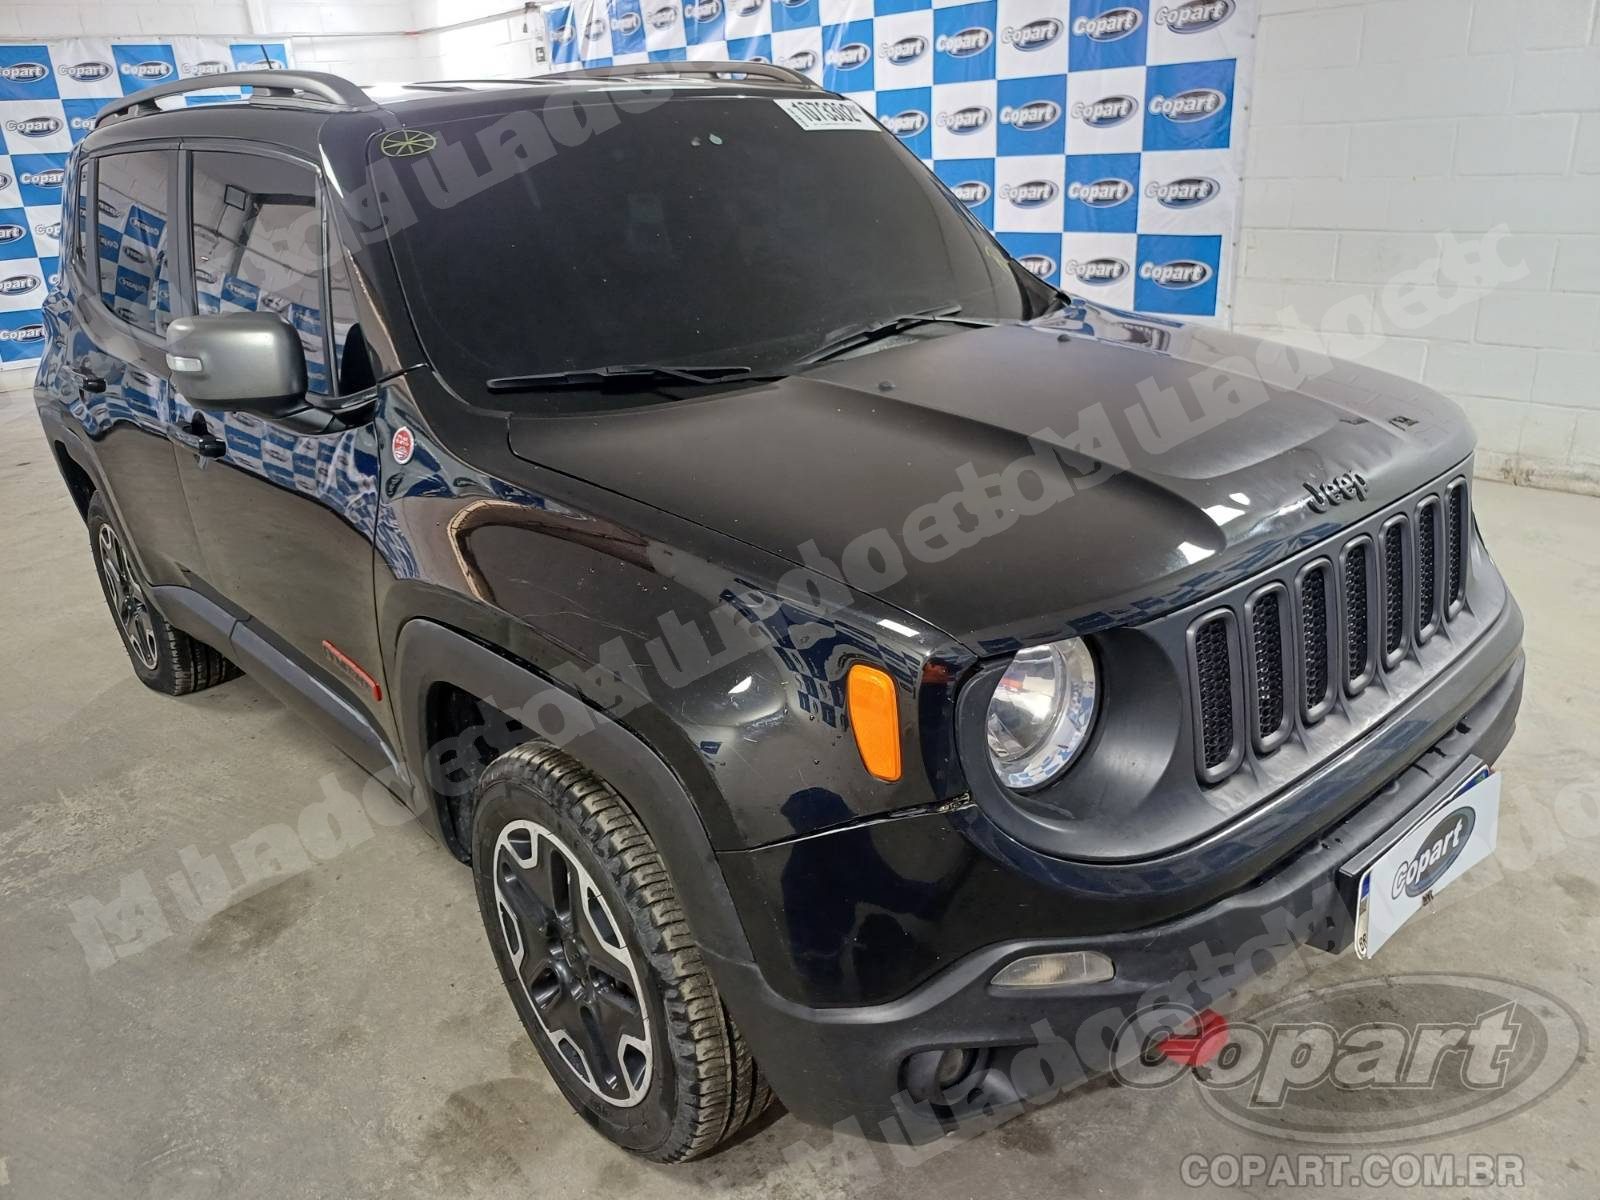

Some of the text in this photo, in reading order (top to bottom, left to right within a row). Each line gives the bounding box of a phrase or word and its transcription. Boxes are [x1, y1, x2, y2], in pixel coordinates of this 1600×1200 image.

[1072, 11, 1134, 37] Copart
[1154, 1, 1224, 28] Copart
[936, 32, 986, 54] Copart
[1001, 22, 1056, 45] Copart
[879, 38, 923, 59] Copart
[0, 65, 42, 80] opart
[58, 64, 106, 80] Copart
[120, 62, 168, 78] Copart
[1000, 104, 1053, 127] Copart
[1071, 99, 1130, 122] Copart
[1149, 92, 1218, 118] Copart
[6, 119, 56, 134] Copart
[936, 109, 986, 131] Copart
[20, 172, 64, 187] Copar
[1000, 183, 1050, 203] Copart
[1068, 181, 1126, 203] Copart
[1145, 180, 1208, 203] Copart
[1066, 259, 1121, 281] Copart
[1139, 261, 1202, 284] Copart
[1303, 471, 1368, 514] Jeep
[1392, 816, 1464, 900] Copart
